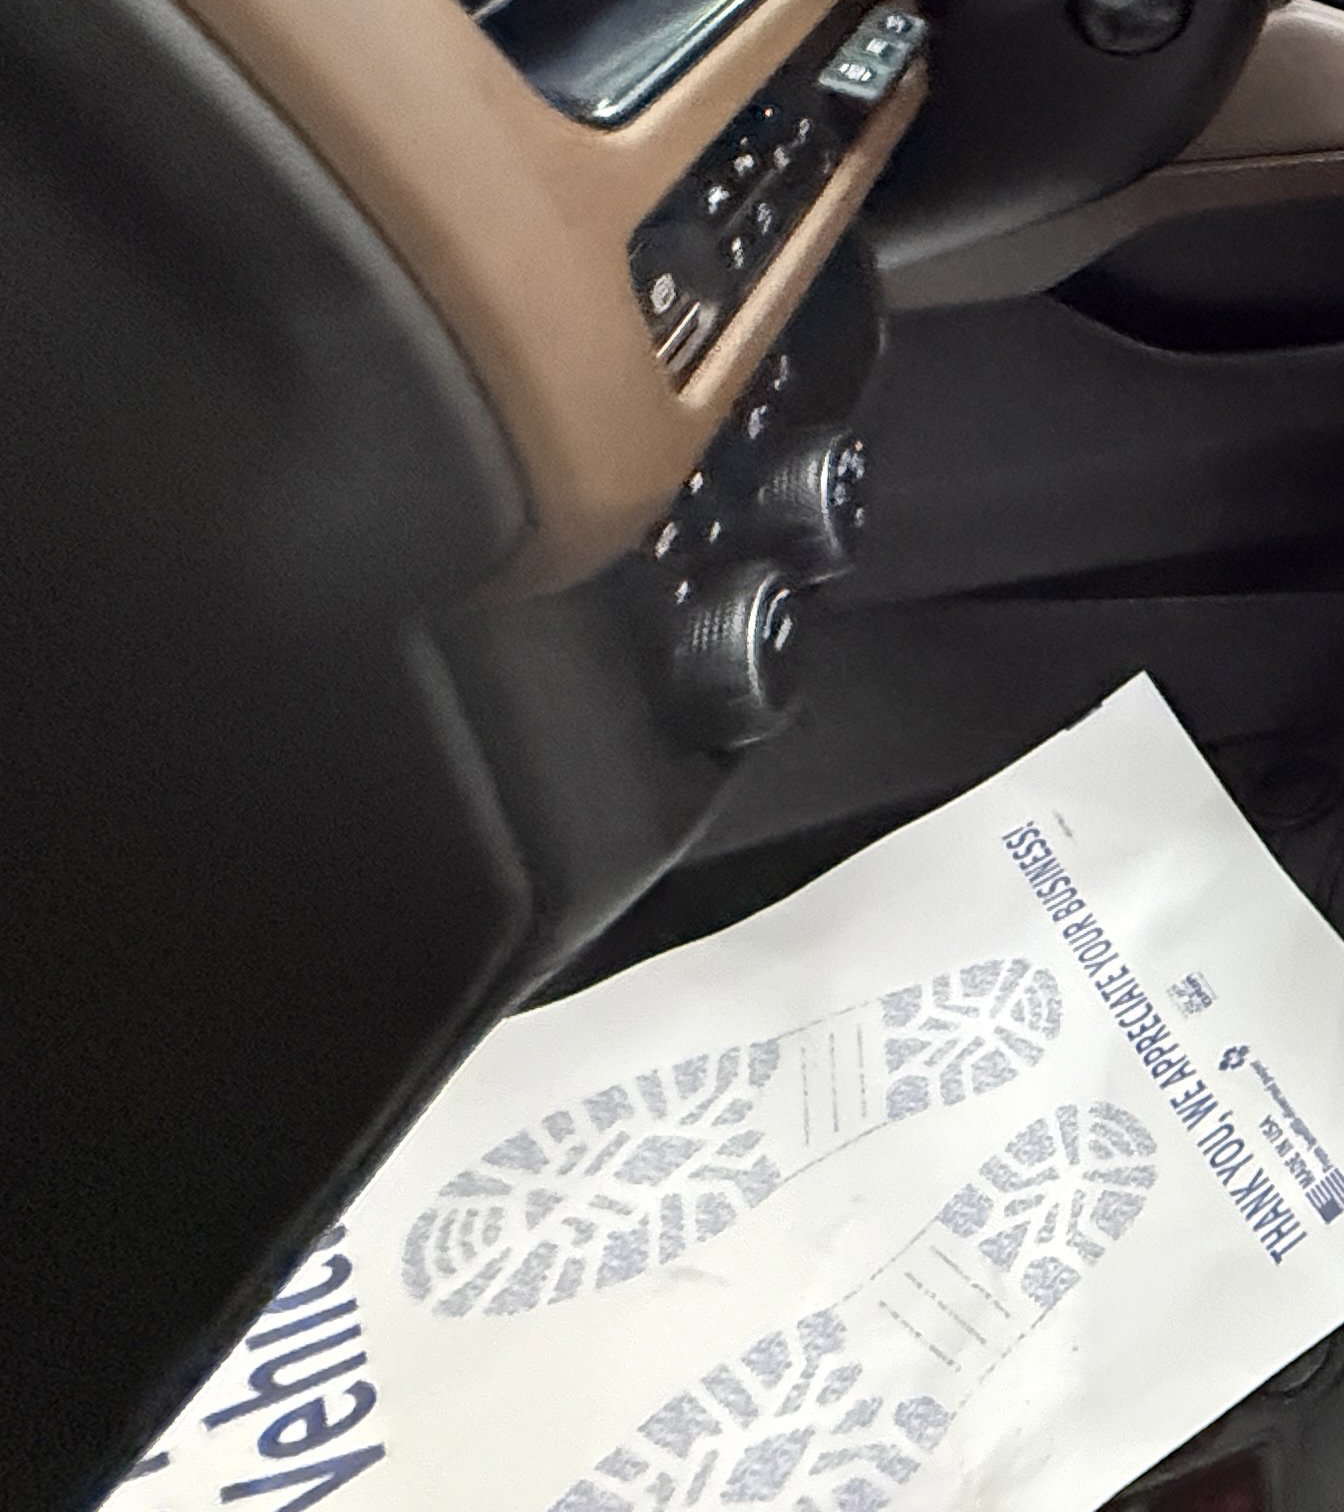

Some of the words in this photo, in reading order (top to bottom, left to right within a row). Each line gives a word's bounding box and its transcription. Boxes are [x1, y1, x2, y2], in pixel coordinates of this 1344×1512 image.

[1002, 821, 1086, 923] BUSINESS!
[1063, 913, 1119, 978] YOUR
[1095, 965, 1196, 1090] APPRECIATE
[1170, 1080, 1218, 1131] WE
[1259, 1115, 1283, 1144] USA
[1197, 1110, 1254, 1187] YOU,
[1275, 1139, 1293, 1157] IN
[1284, 1152, 1314, 1189] MADE
[1229, 1168, 1307, 1266] THANK
[203, 1224, 386, 1512] Vehic
